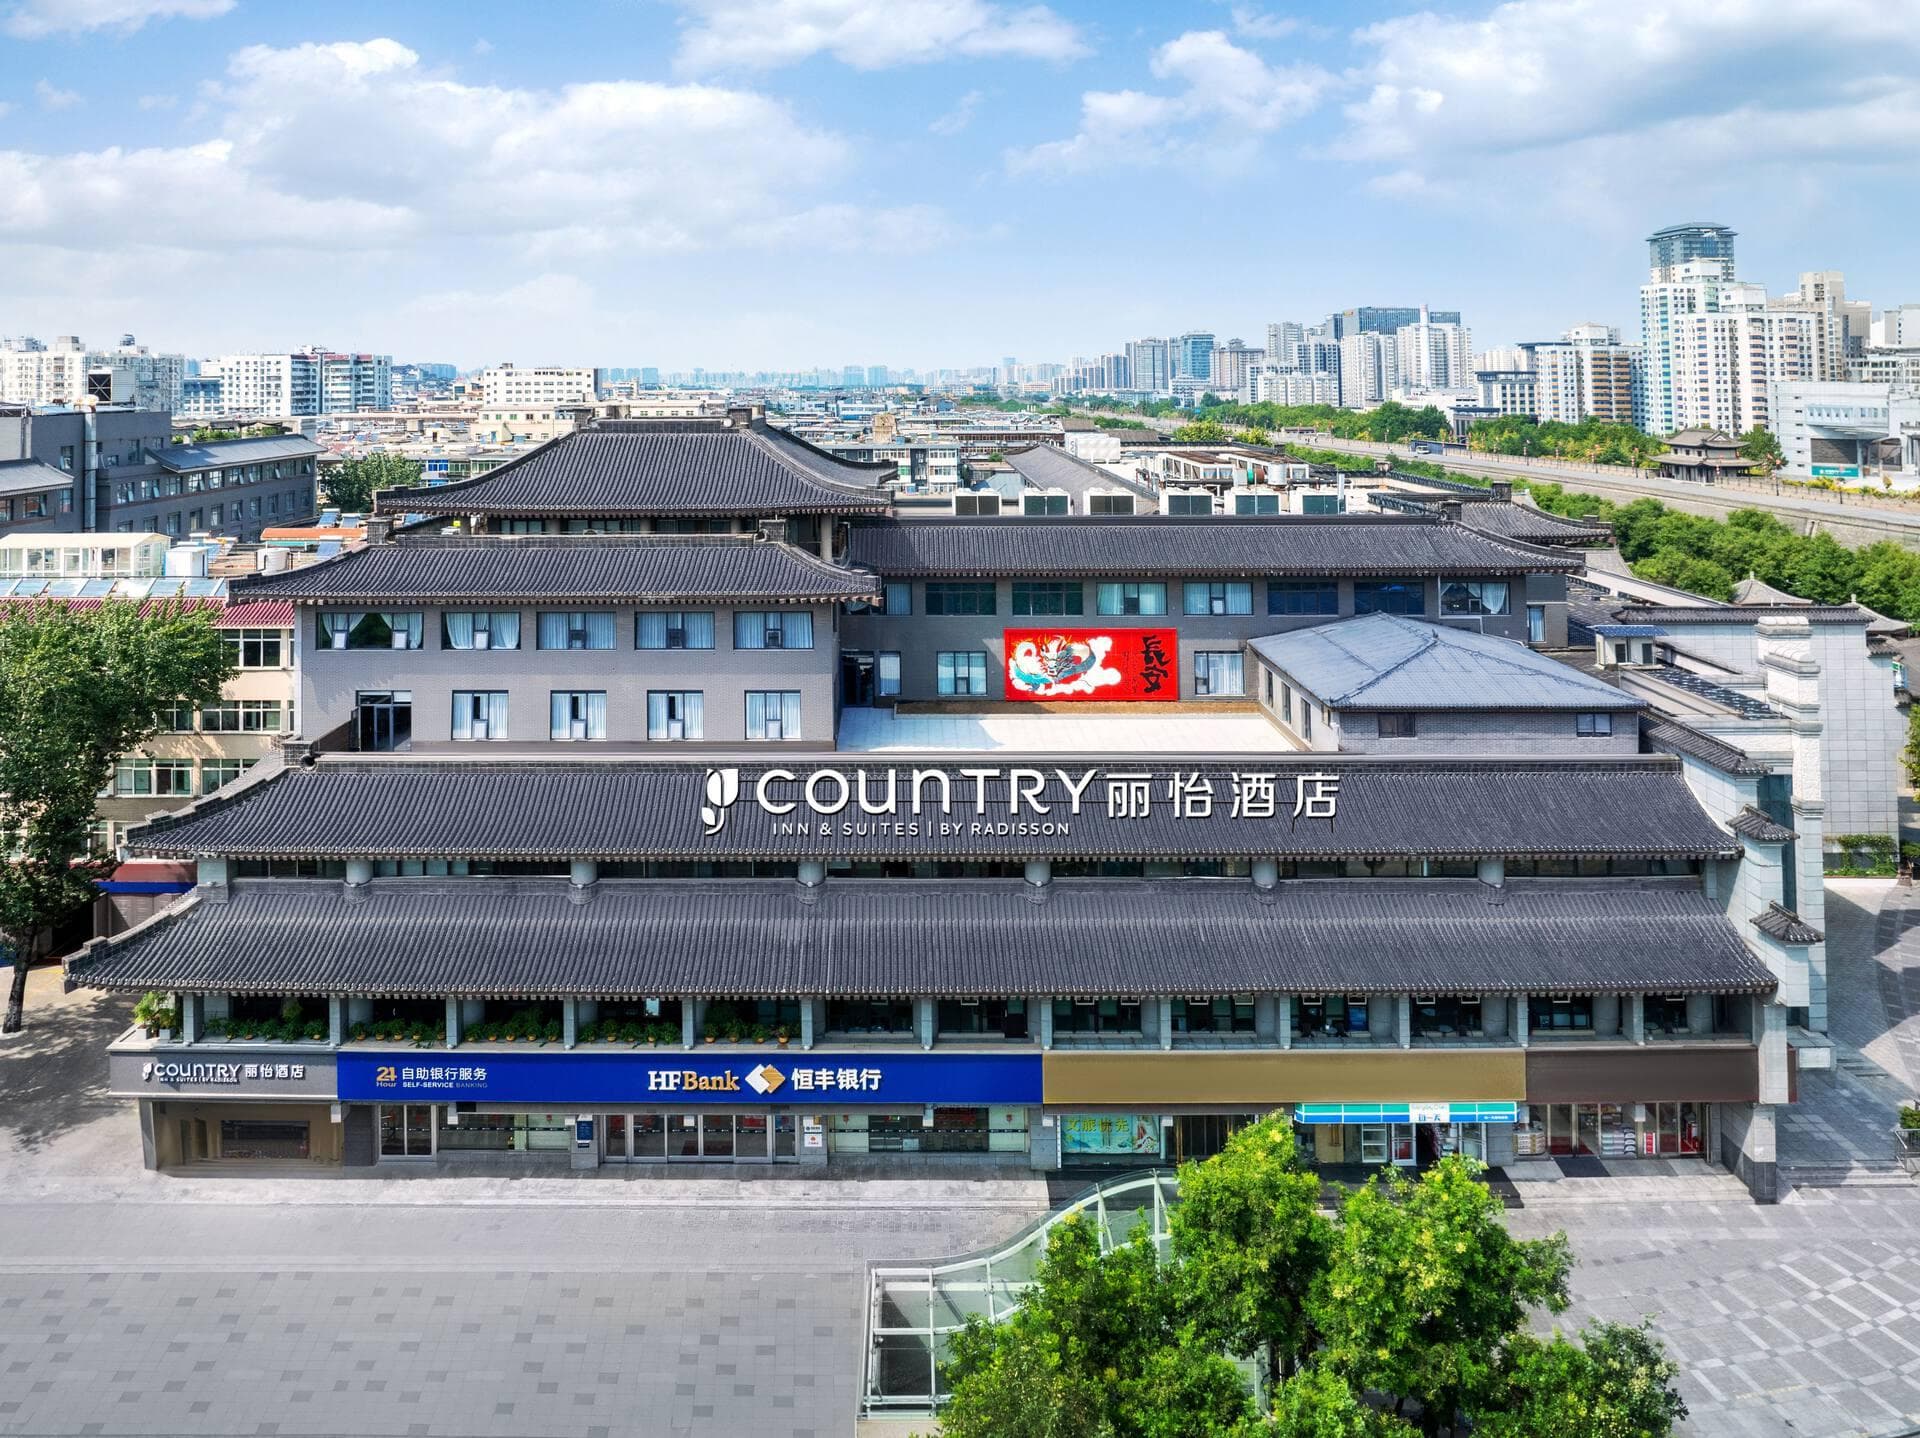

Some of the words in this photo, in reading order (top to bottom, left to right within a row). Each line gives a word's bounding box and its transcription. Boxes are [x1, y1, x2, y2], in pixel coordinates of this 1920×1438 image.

[755, 768, 1097, 816] COUNTRY
[1106, 771, 1341, 819] 丽怡酒店
[772, 822, 809, 836] INN
[819, 822, 833, 836] &
[842, 822, 919, 836] SUITES
[940, 822, 962, 836] BY
[970, 822, 1070, 836] RADISSON
[154, 1063, 242, 1077] COUNTRY
[244, 1064, 305, 1078] 丽怡酒店
[402, 1067, 488, 1081] 自助银行服务
[791, 1068, 882, 1091] 恒丰银行
[648, 1070, 740, 1092] HFBank
